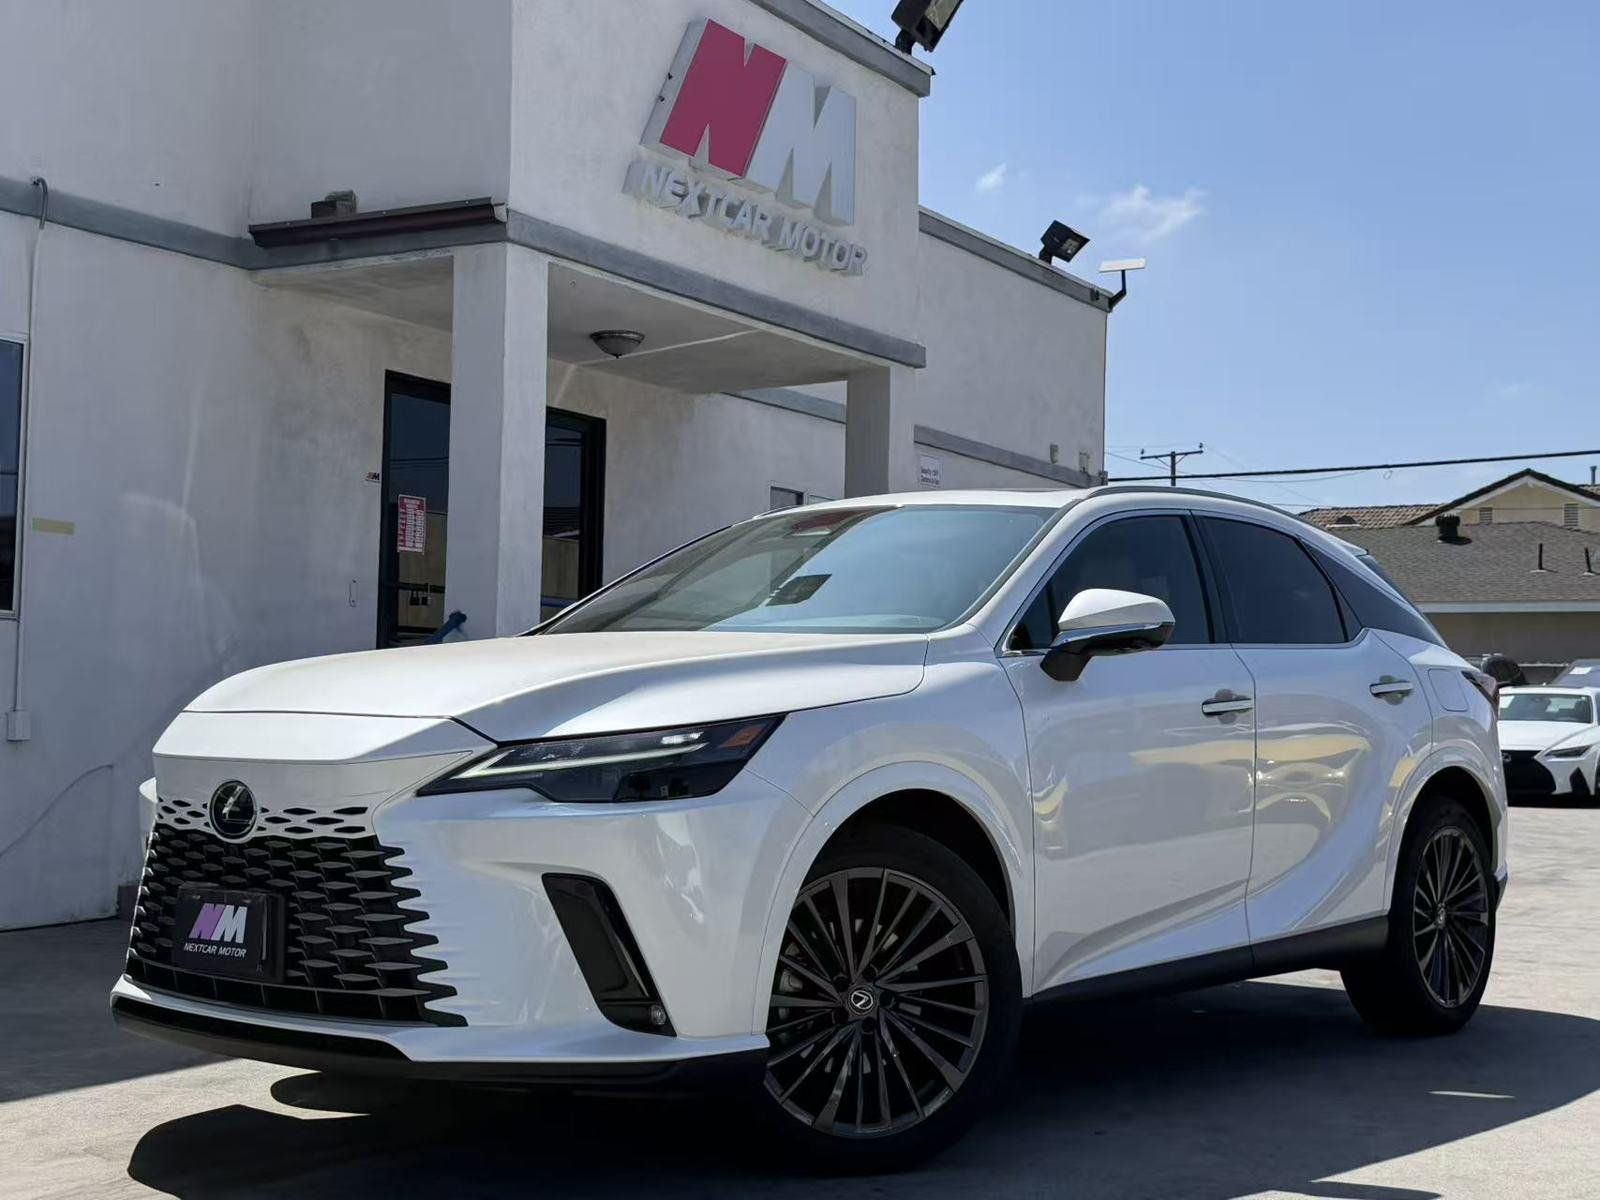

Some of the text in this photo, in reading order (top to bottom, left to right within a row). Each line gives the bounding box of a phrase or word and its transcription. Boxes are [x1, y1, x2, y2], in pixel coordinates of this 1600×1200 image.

[641, 17, 857, 225] NM
[628, 163, 868, 275] NEXTCAR MOTOR
[184, 942, 246, 958] NEXTCAR MOTOR
[188, 903, 248, 944] NM
